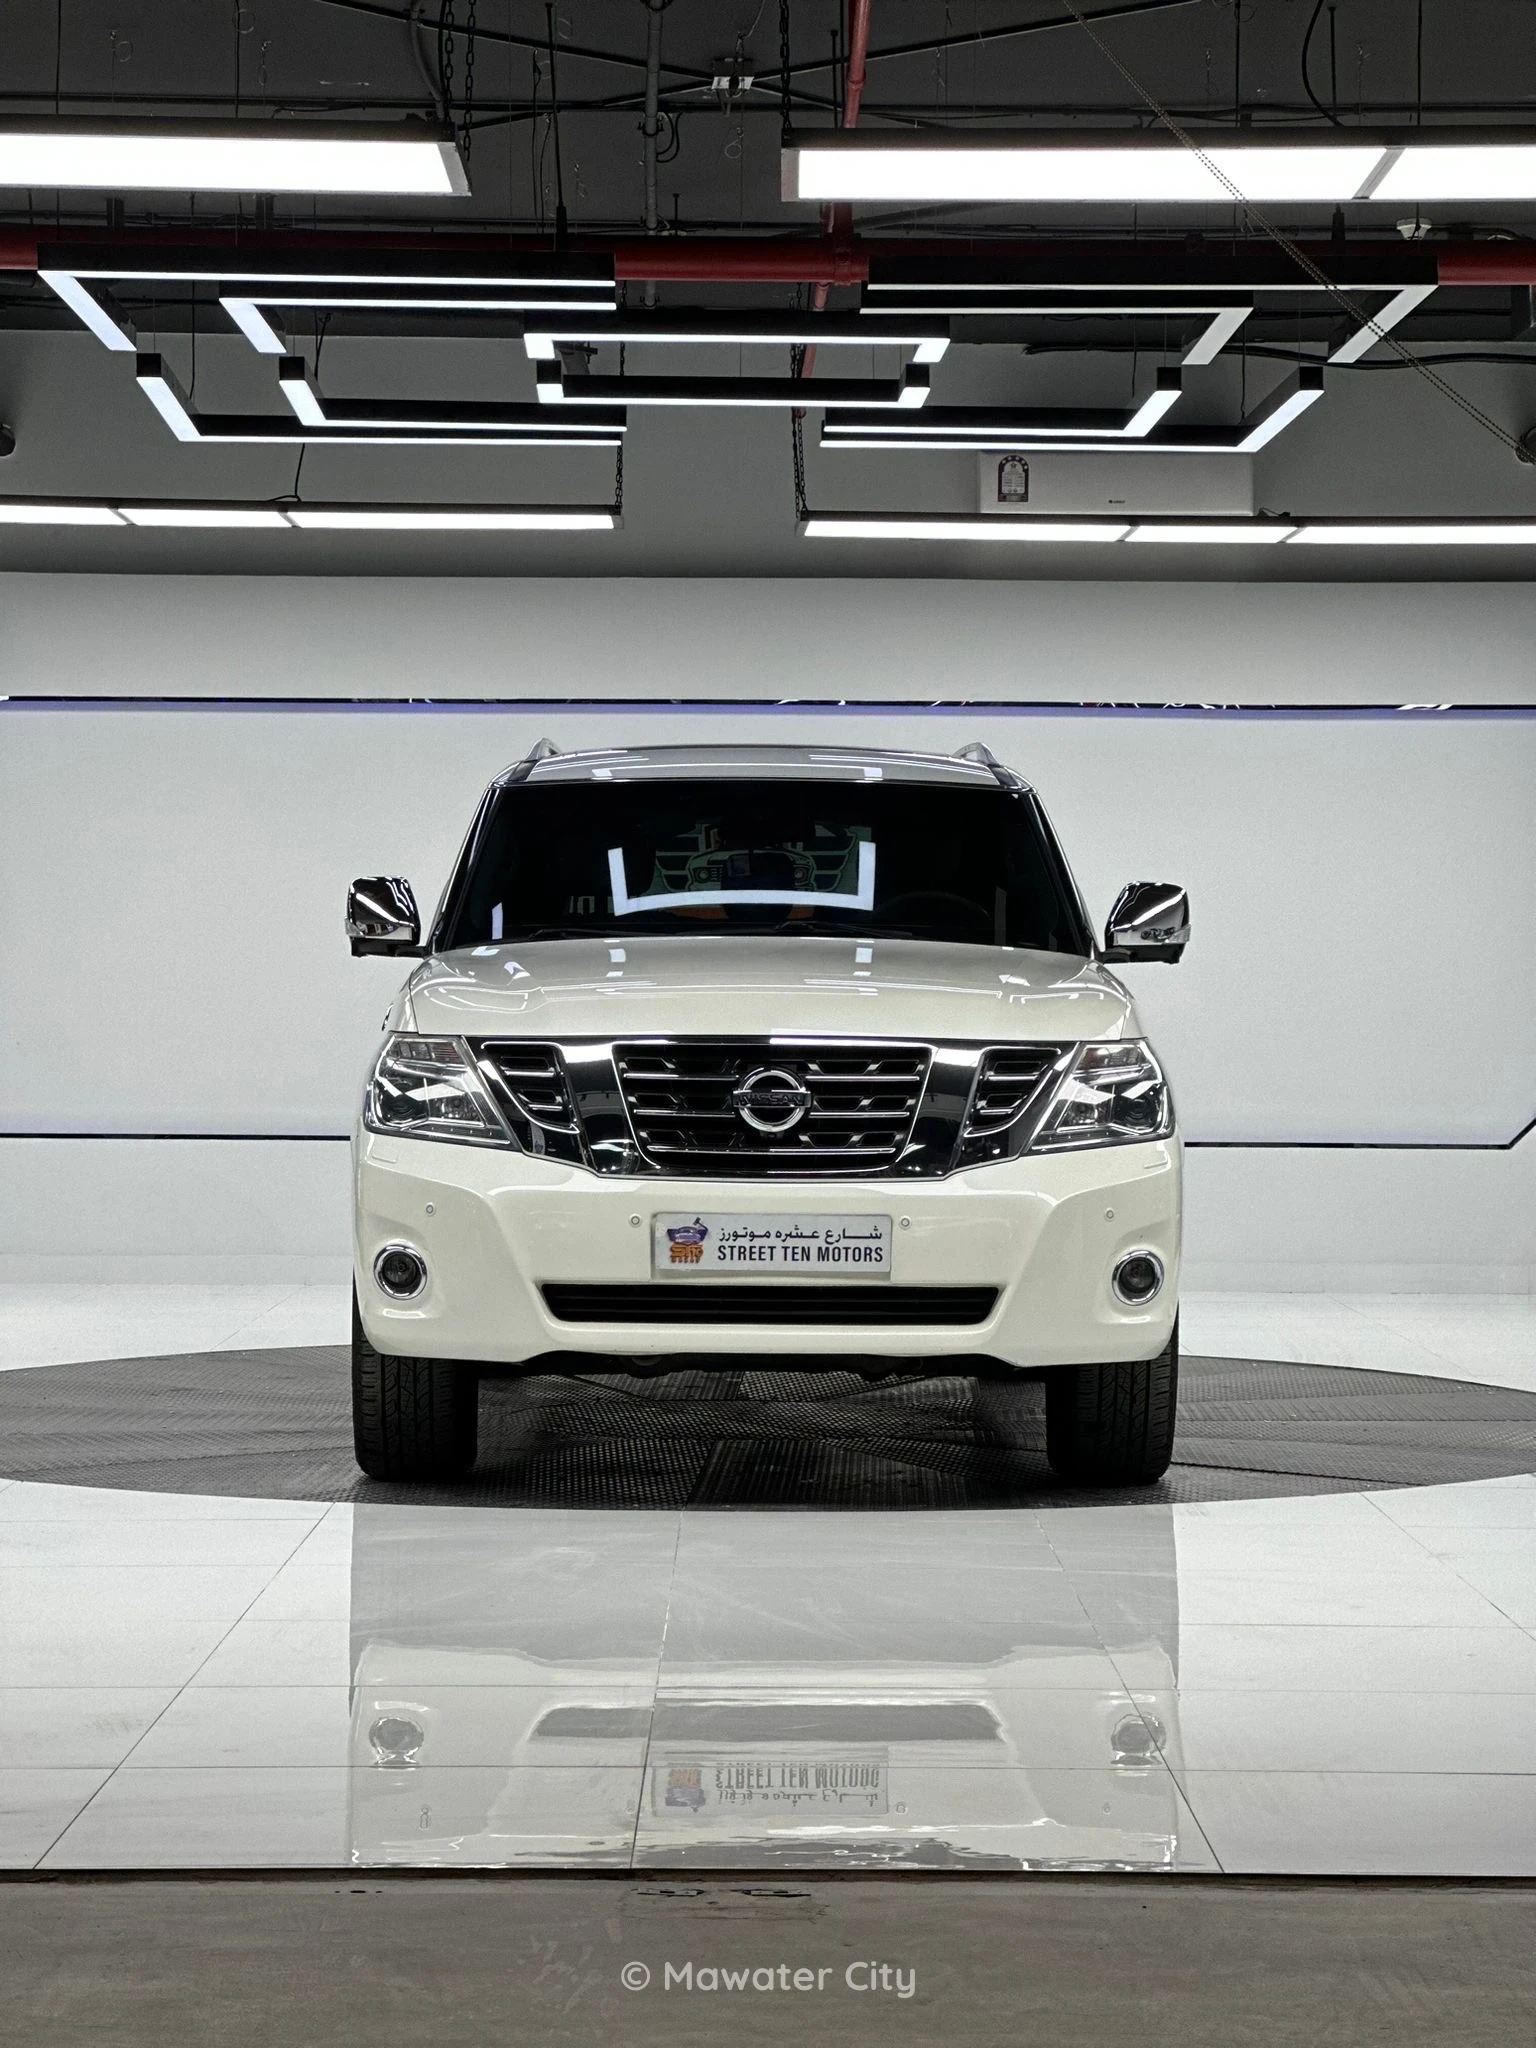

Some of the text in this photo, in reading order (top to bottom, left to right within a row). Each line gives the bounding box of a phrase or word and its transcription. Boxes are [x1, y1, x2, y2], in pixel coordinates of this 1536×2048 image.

[717, 1226, 772, 1243] موتورز
[824, 1225, 883, 1246] شارع
[717, 1245, 777, 1262] STREET
[781, 1245, 811, 1262] TEN
[816, 1246, 884, 1263] MOTORS
